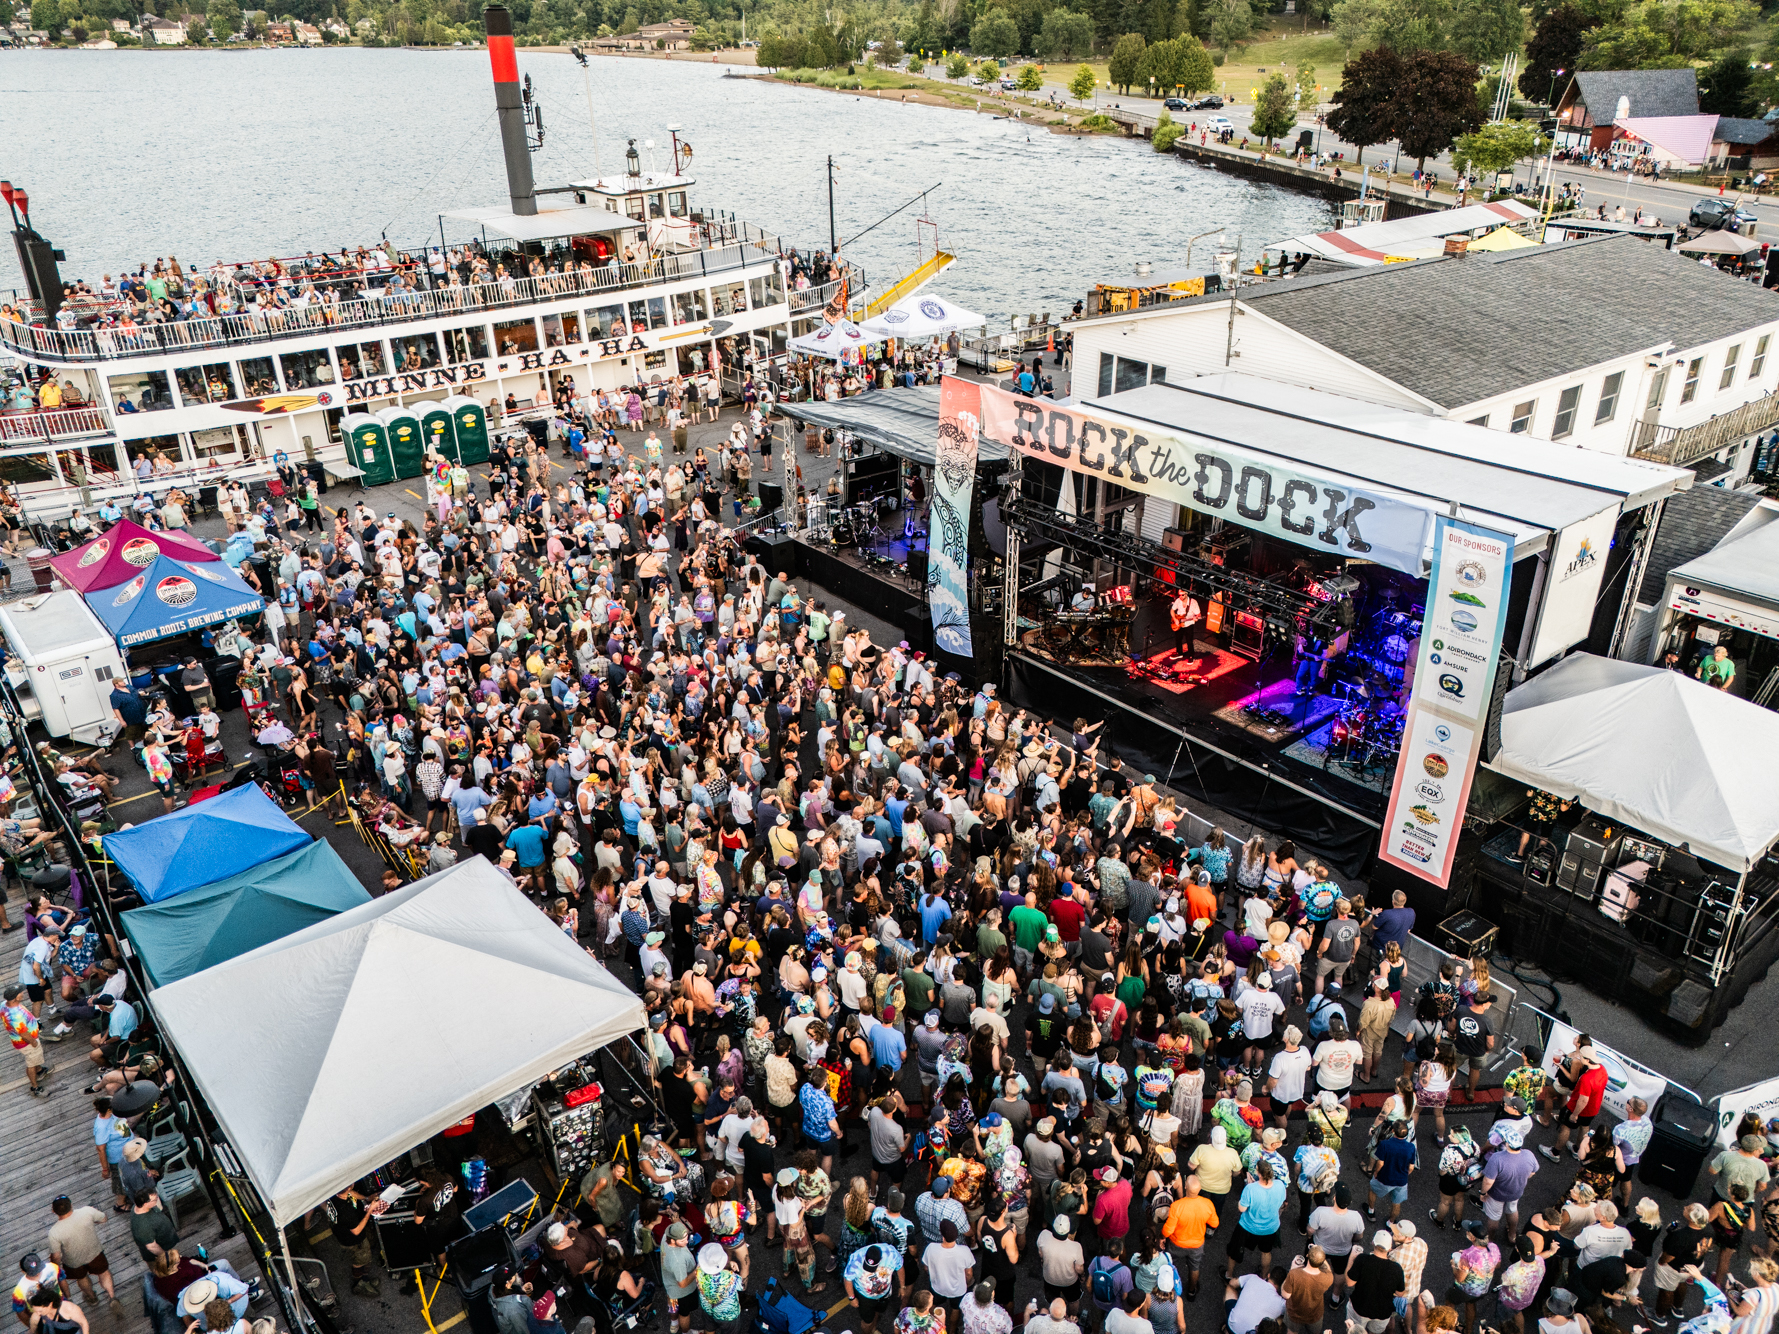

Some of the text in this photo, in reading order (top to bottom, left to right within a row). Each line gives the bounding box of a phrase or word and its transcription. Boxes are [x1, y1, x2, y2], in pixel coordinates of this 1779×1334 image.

[1012, 400, 1377, 554] ROCK the DOCK
[1448, 533, 1501, 556] OUR SPONSORS
[1564, 550, 1597, 576] APEX
[121, 631, 159, 646] COMMON
[159, 621, 187, 636] ROOTS
[187, 611, 225, 628] BREWING
[226, 600, 261, 617] COMPANY
[1446, 644, 1487, 663] ADIRONDACK
[1443, 660, 1469, 673] AMSURE
[1421, 785, 1439, 799] EQX
[1402, 843, 1414, 852] THAN
[1405, 839, 1425, 851] BETTER
